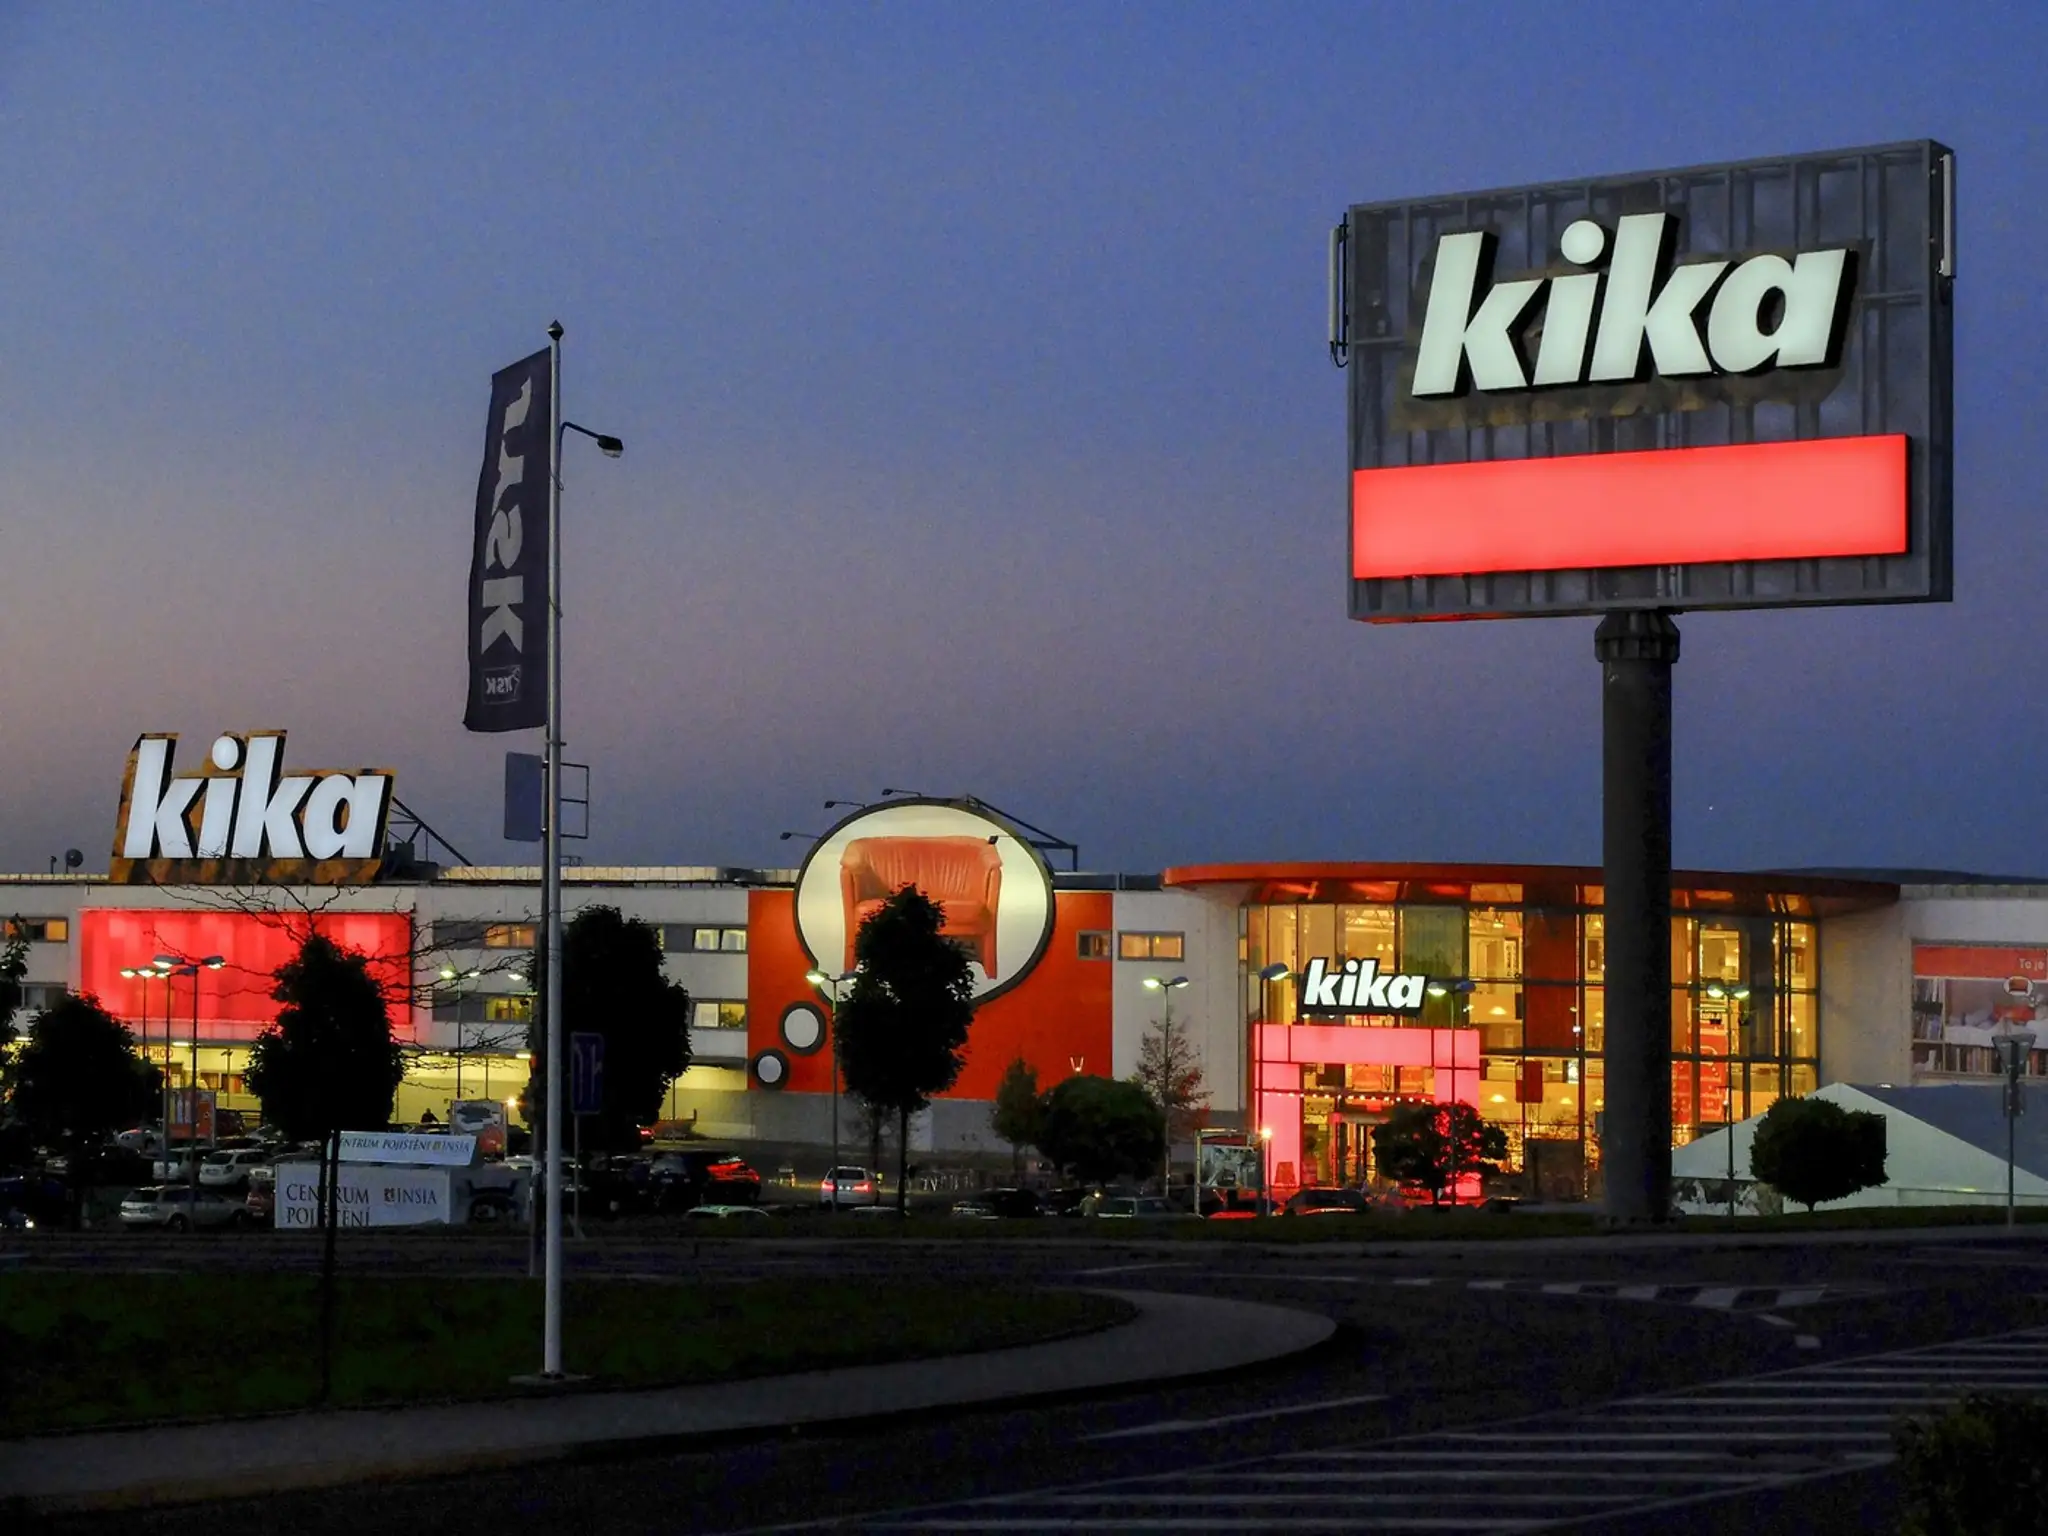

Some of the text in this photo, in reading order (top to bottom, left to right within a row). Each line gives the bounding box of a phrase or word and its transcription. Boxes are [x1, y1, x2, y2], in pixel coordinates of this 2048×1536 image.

[1412, 212, 1848, 397] kika
[123, 735, 386, 860] kika
[1303, 958, 1426, 1009] kika
[339, 1137, 379, 1149] NTRUM
[397, 1186, 437, 1205] INSIA
[286, 1206, 370, 1228] POJĚNÍ
